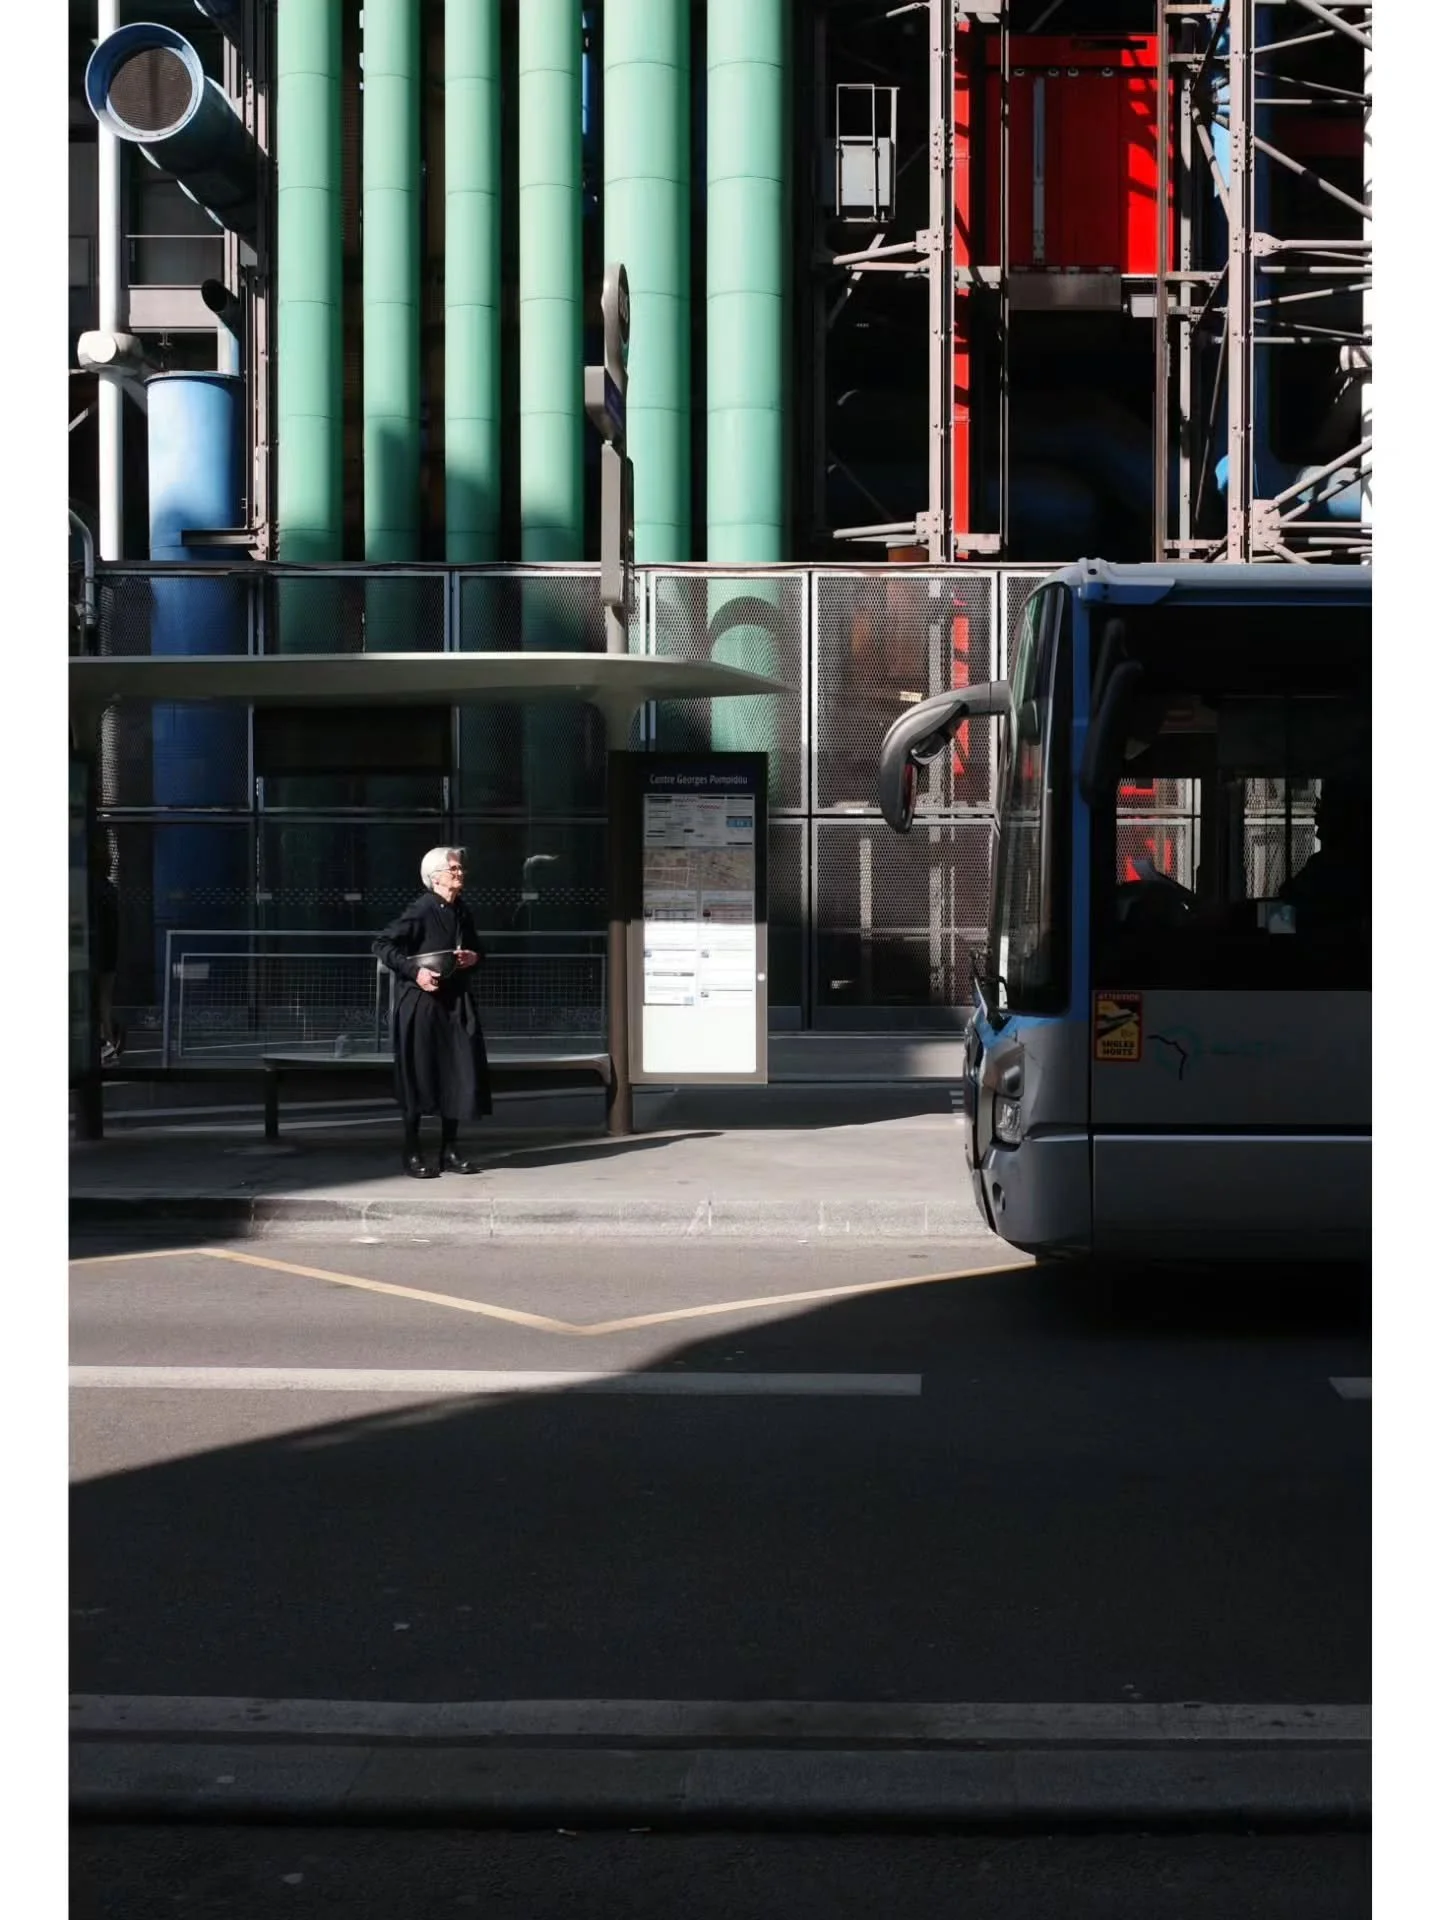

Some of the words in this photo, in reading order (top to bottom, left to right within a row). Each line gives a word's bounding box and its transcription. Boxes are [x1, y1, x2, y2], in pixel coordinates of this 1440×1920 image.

[649, 773, 676, 785] Centre
[677, 773, 708, 787] Georges
[710, 774, 748, 786] Pompidou
